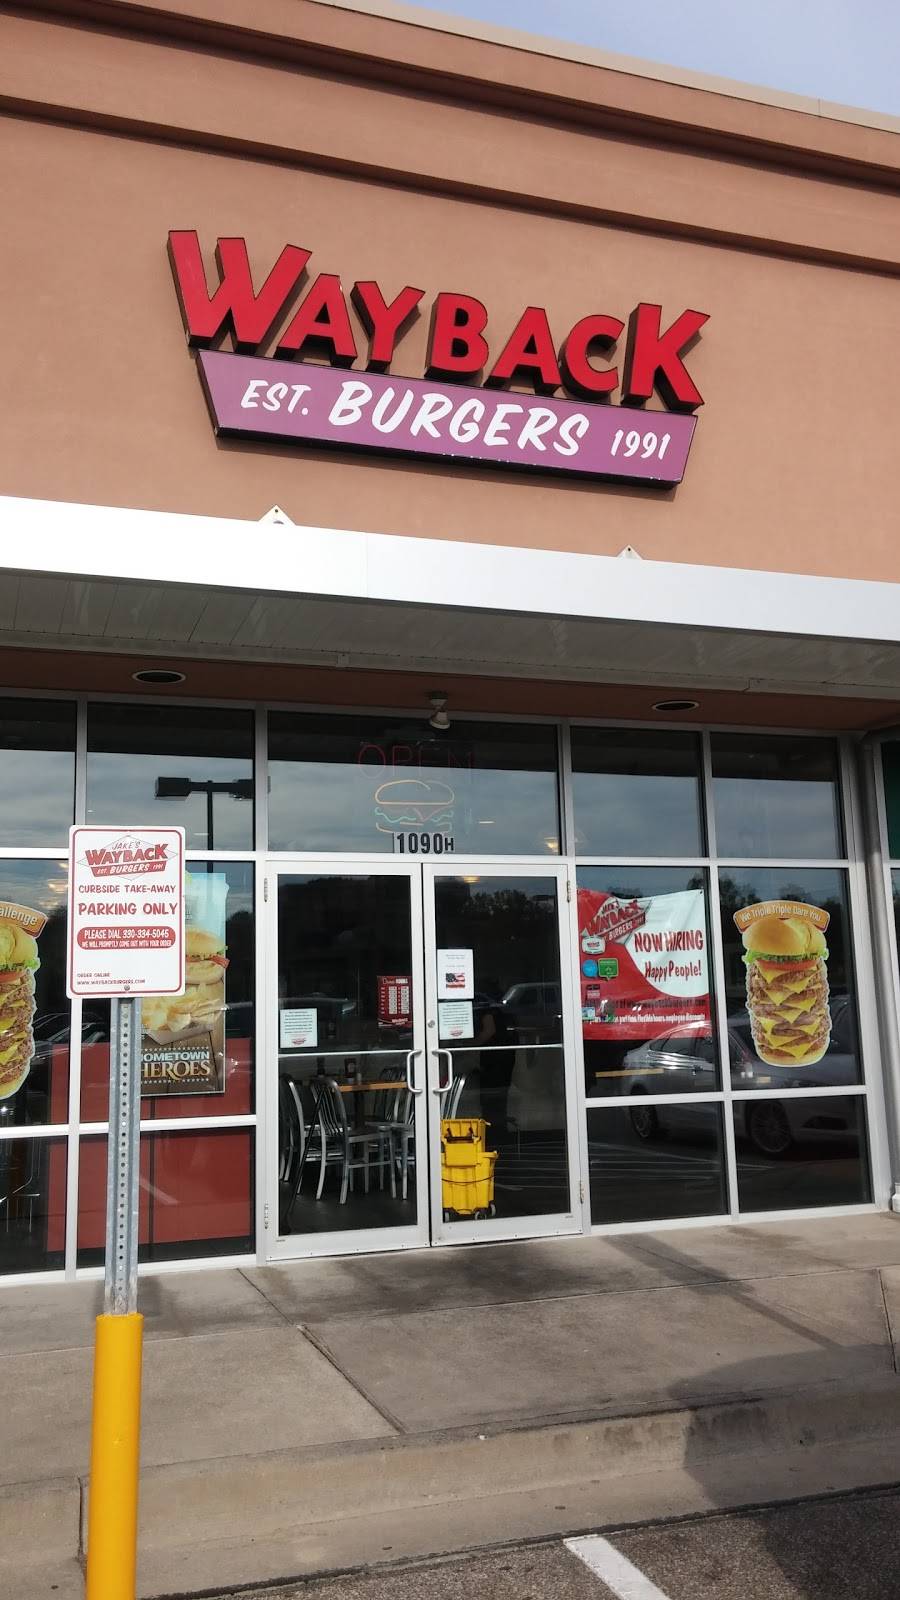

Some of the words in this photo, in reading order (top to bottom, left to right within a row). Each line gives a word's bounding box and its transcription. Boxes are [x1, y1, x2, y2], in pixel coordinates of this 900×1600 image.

[167, 230, 711, 408] WAYBACK
[240, 380, 310, 416] EST.
[328, 381, 591, 457] BURGERS
[610, 430, 671, 460] 1991
[358, 744, 475, 780] OPEN
[85, 843, 168, 866] WAYBACK
[112, 841, 141, 850] JAKE'S
[109, 863, 149, 875] BURGERS
[78, 885, 120, 894] CURBSIDE
[125, 884, 176, 894] TAKE-AWAY
[0, 906, 38, 926] allenge
[78, 902, 137, 915] PARKING
[142, 902, 178, 915] ONLY
[752, 906, 770, 918] Triple
[772, 903, 792, 915] Triple
[84, 929, 107, 939] PLEASE
[108, 929, 121, 939] DIAL
[634, 931, 663, 953] NOW
[664, 929, 704, 953] HIRING
[644, 959, 668, 983] Happy
[668, 959, 702, 981] People!
